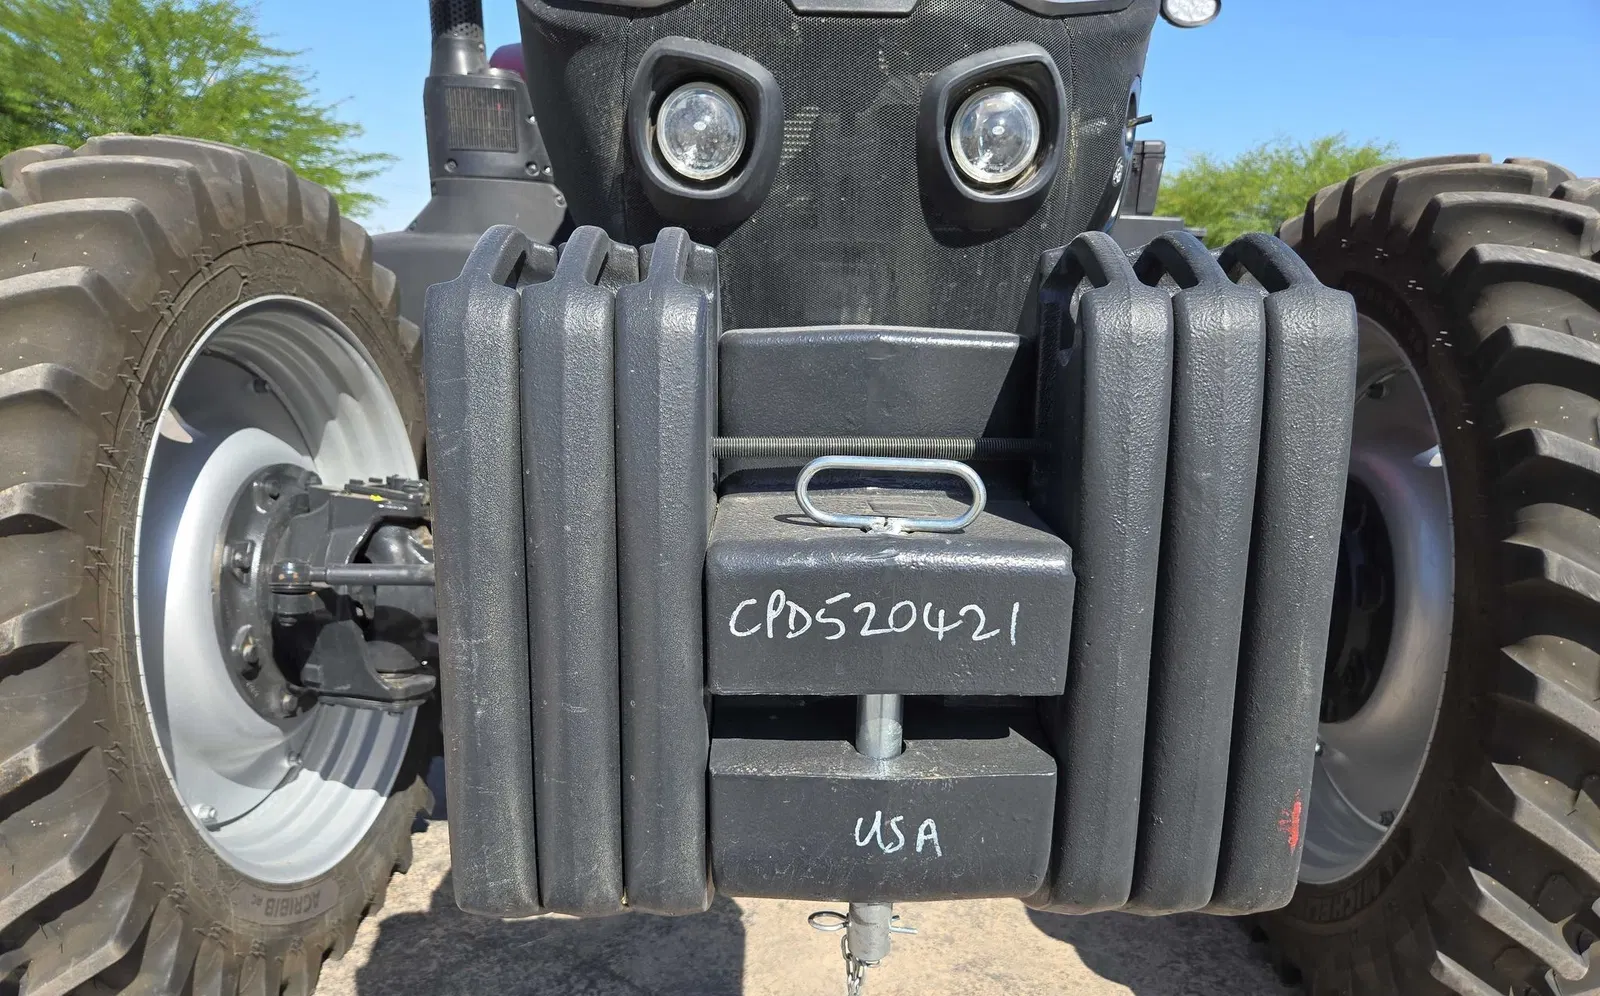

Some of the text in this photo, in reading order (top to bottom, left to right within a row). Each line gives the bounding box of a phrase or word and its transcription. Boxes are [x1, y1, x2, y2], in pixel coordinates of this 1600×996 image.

[728, 589, 1020, 646] CPD520421
[854, 810, 942, 857] USA
[264, 890, 321, 918] AGRIBIB
